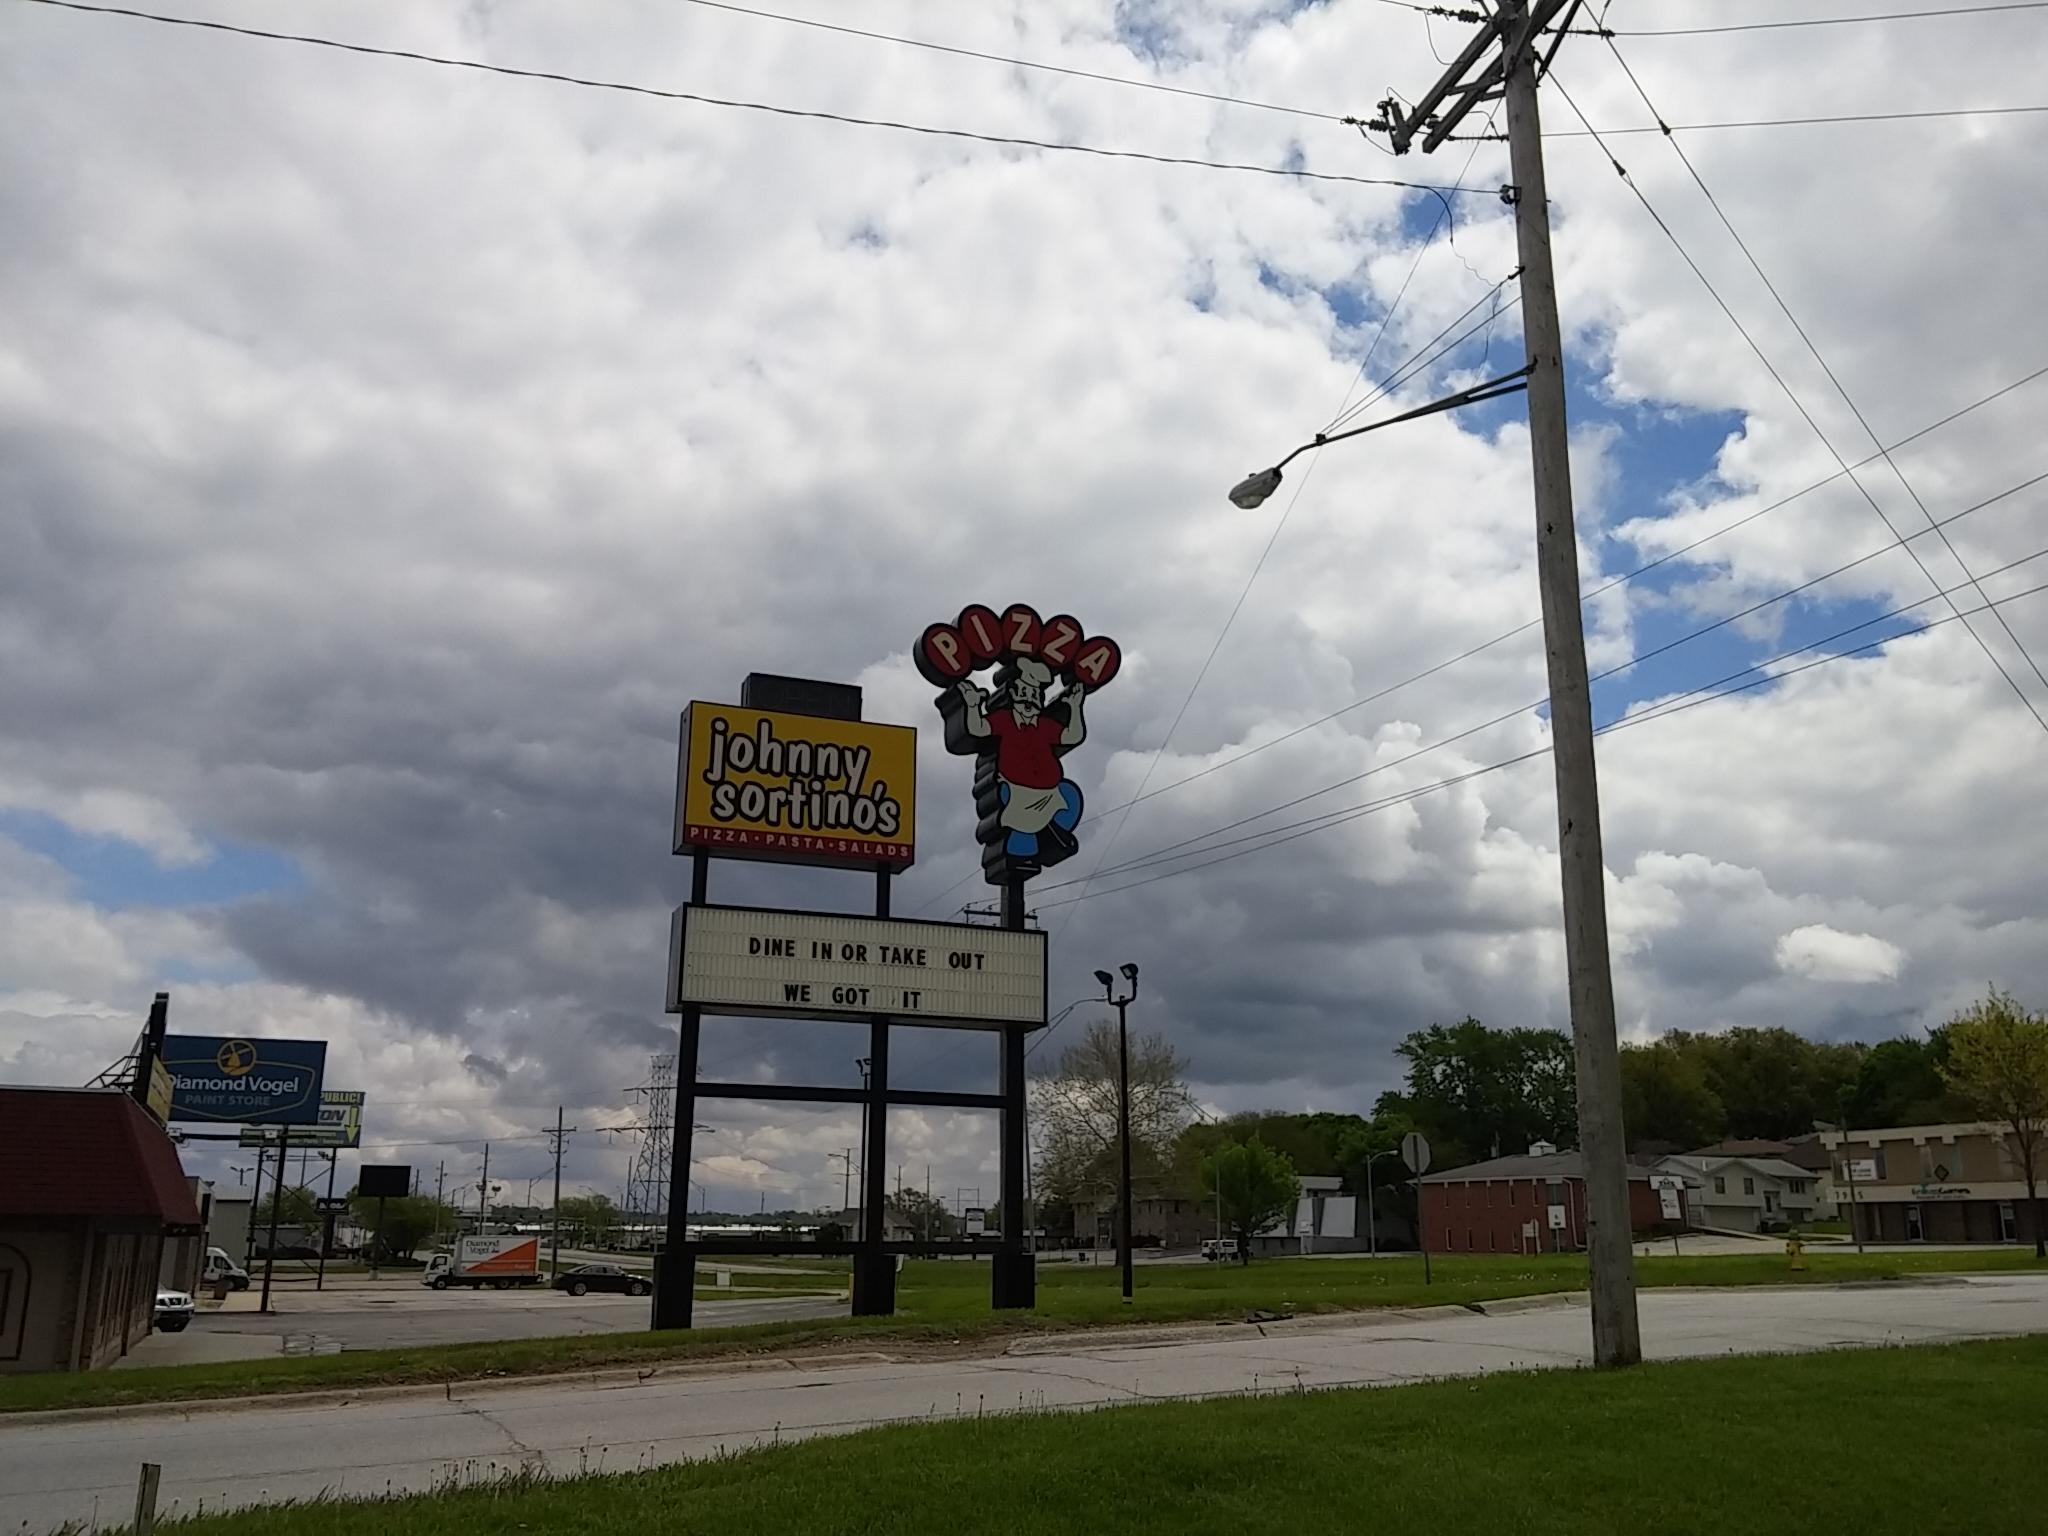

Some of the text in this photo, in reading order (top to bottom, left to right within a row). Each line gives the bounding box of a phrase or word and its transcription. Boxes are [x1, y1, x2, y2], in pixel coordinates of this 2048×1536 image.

[932, 612, 1111, 681] PIZZA
[705, 718, 870, 796] johnny
[713, 781, 899, 834] sortino's
[690, 827, 910, 858] PIZZA PASTA SALADS
[748, 937, 985, 971] DINE IN OR TAKE OUT
[784, 984, 921, 1009] WE GOT IT
[185, 1095, 271, 1106] PAINT STORE
[248, 1076, 299, 1095] Vogel
